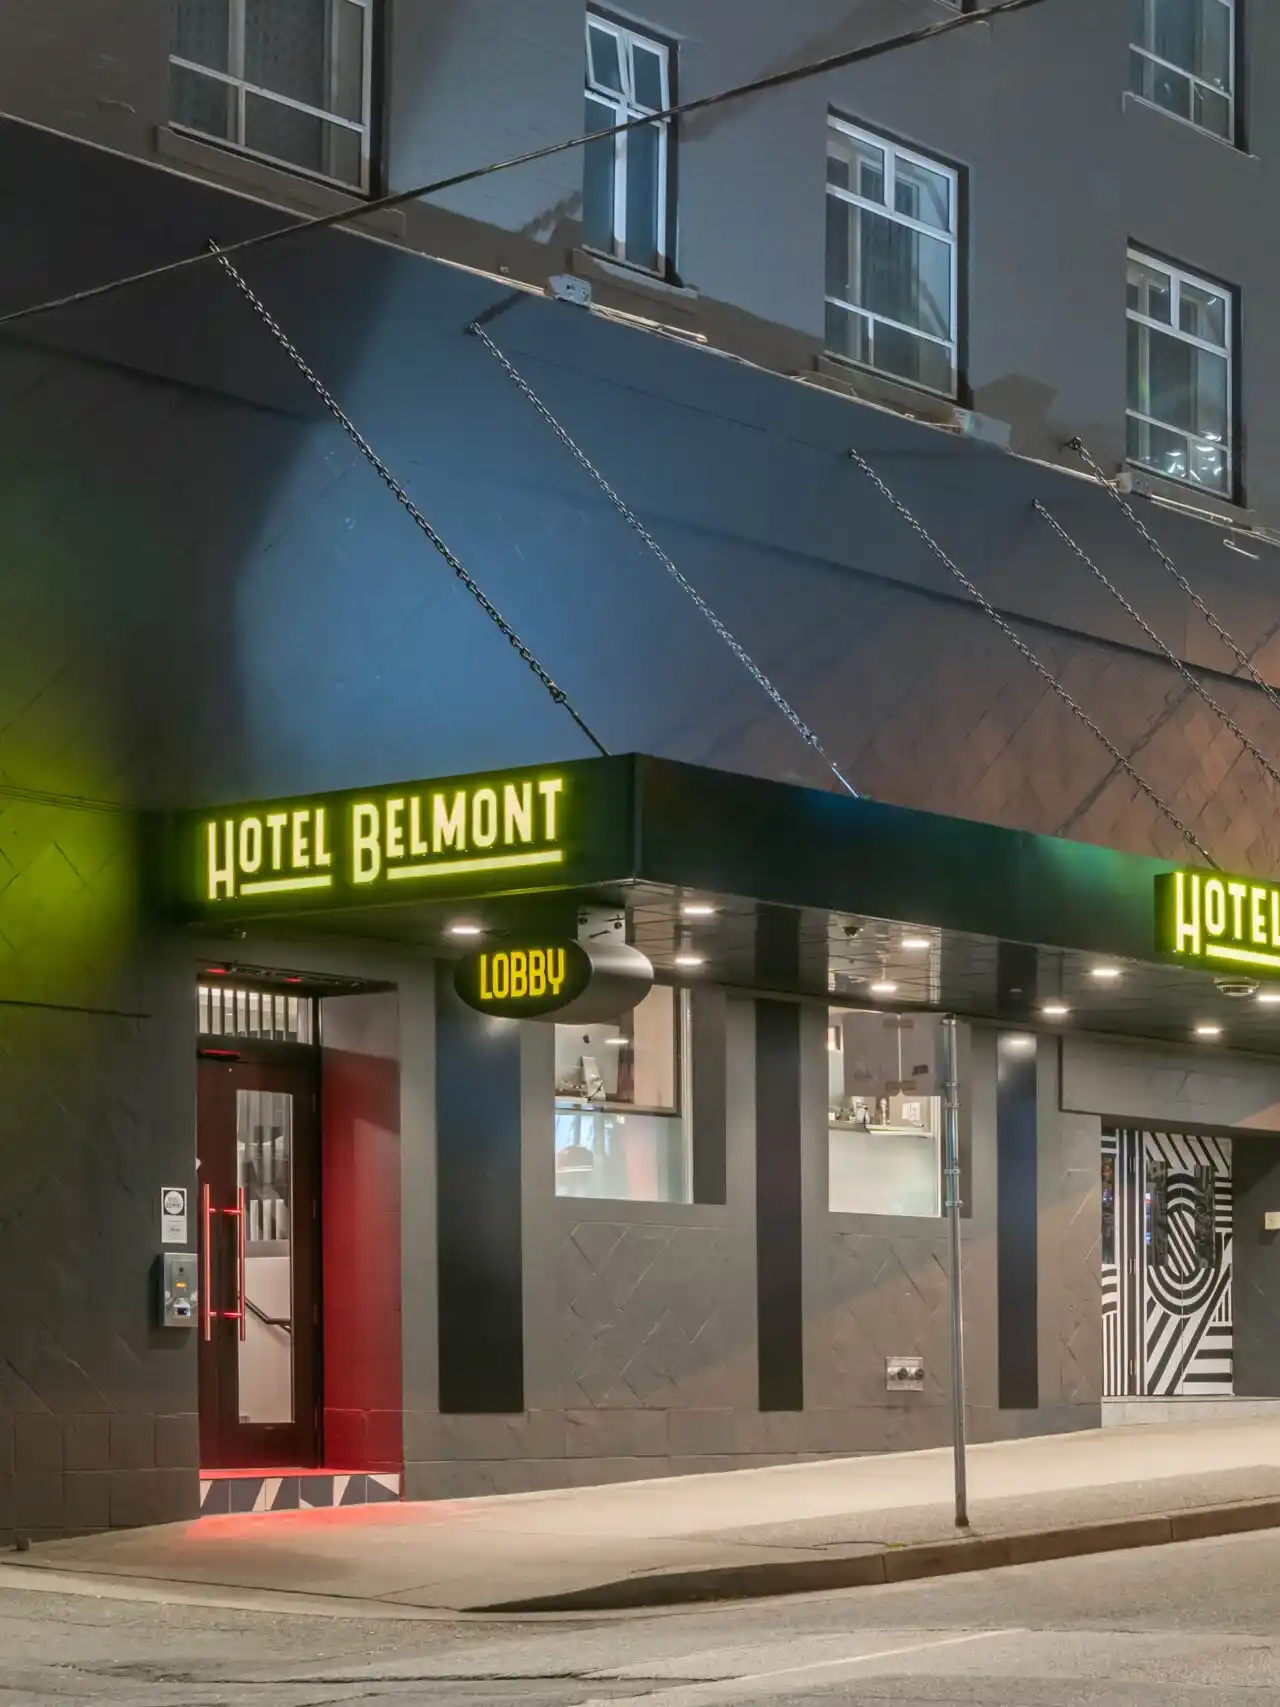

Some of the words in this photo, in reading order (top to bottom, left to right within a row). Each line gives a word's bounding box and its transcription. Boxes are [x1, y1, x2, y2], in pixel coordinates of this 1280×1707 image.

[207, 807, 332, 899] HOTEL
[352, 778, 563, 885] BELMONT
[479, 947, 566, 1000] LOBBY
